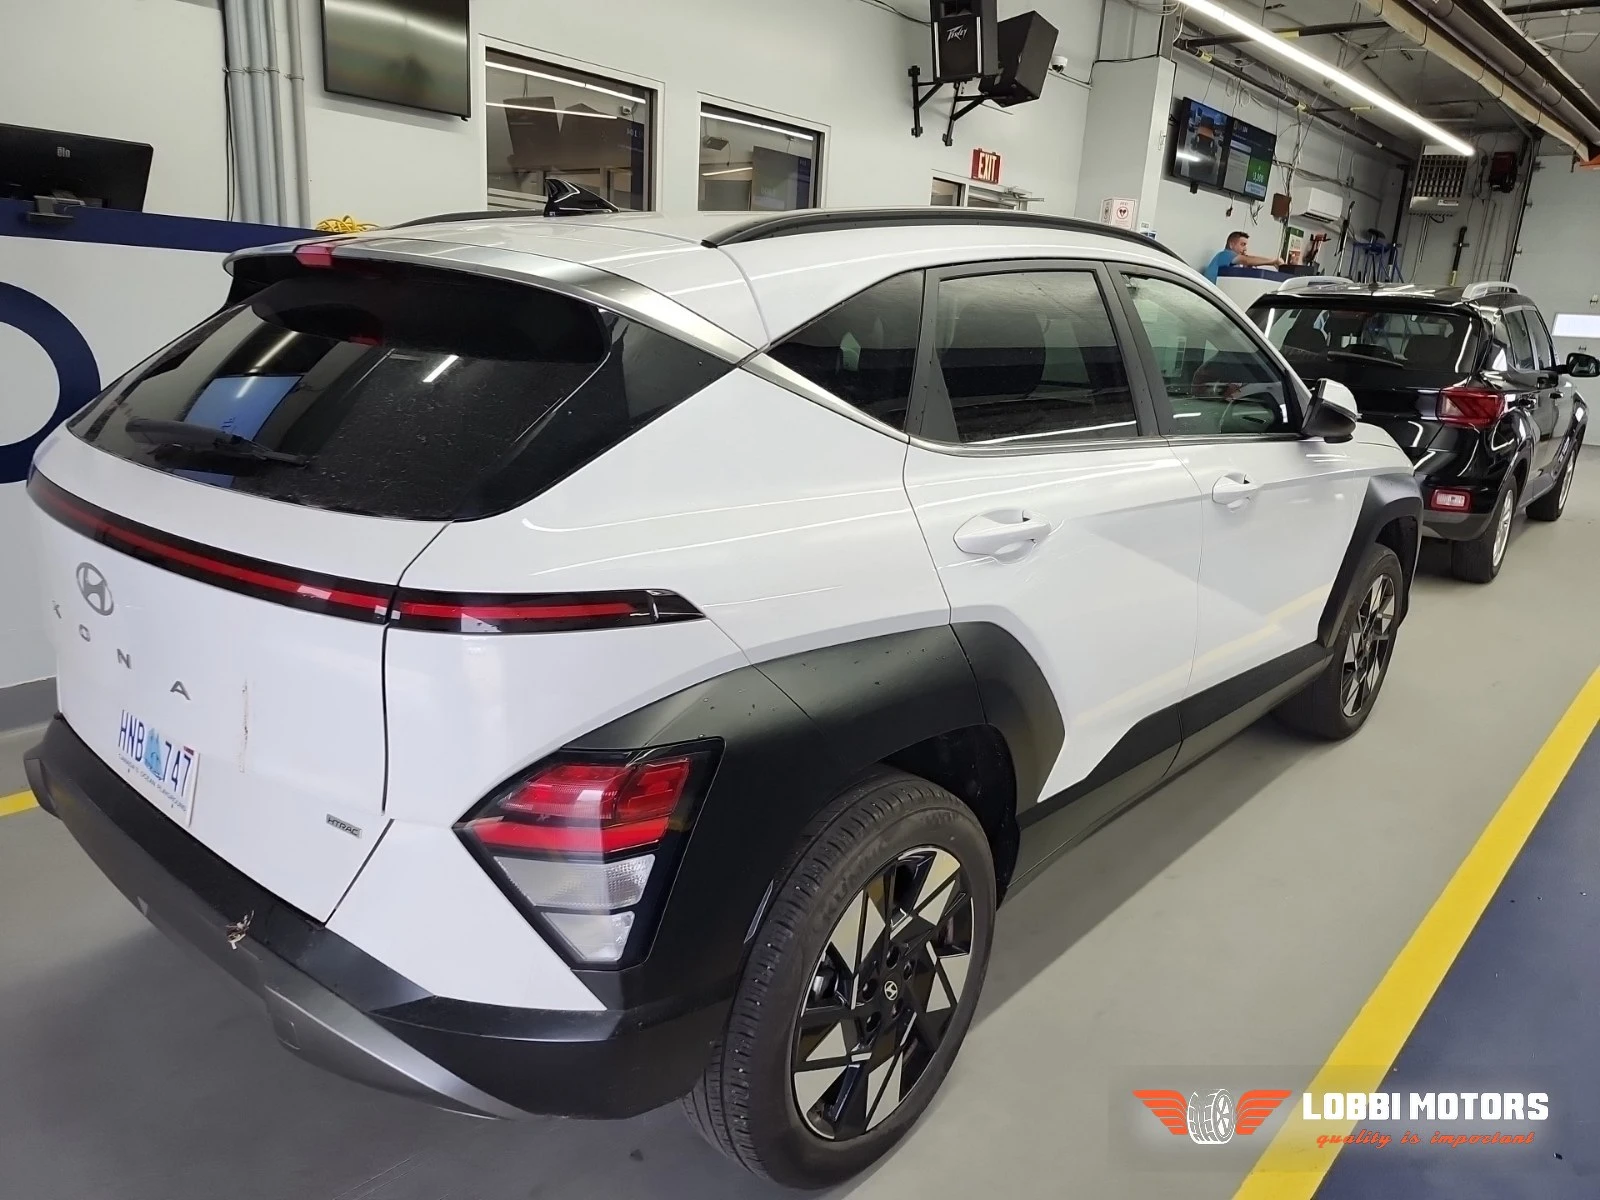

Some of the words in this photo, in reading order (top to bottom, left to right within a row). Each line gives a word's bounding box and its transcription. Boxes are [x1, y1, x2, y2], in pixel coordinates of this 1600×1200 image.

[978, 152, 997, 181] EXIT
[118, 709, 145, 762] HNB
[162, 740, 192, 797] 747
[327, 816, 359, 837] HTRAC
